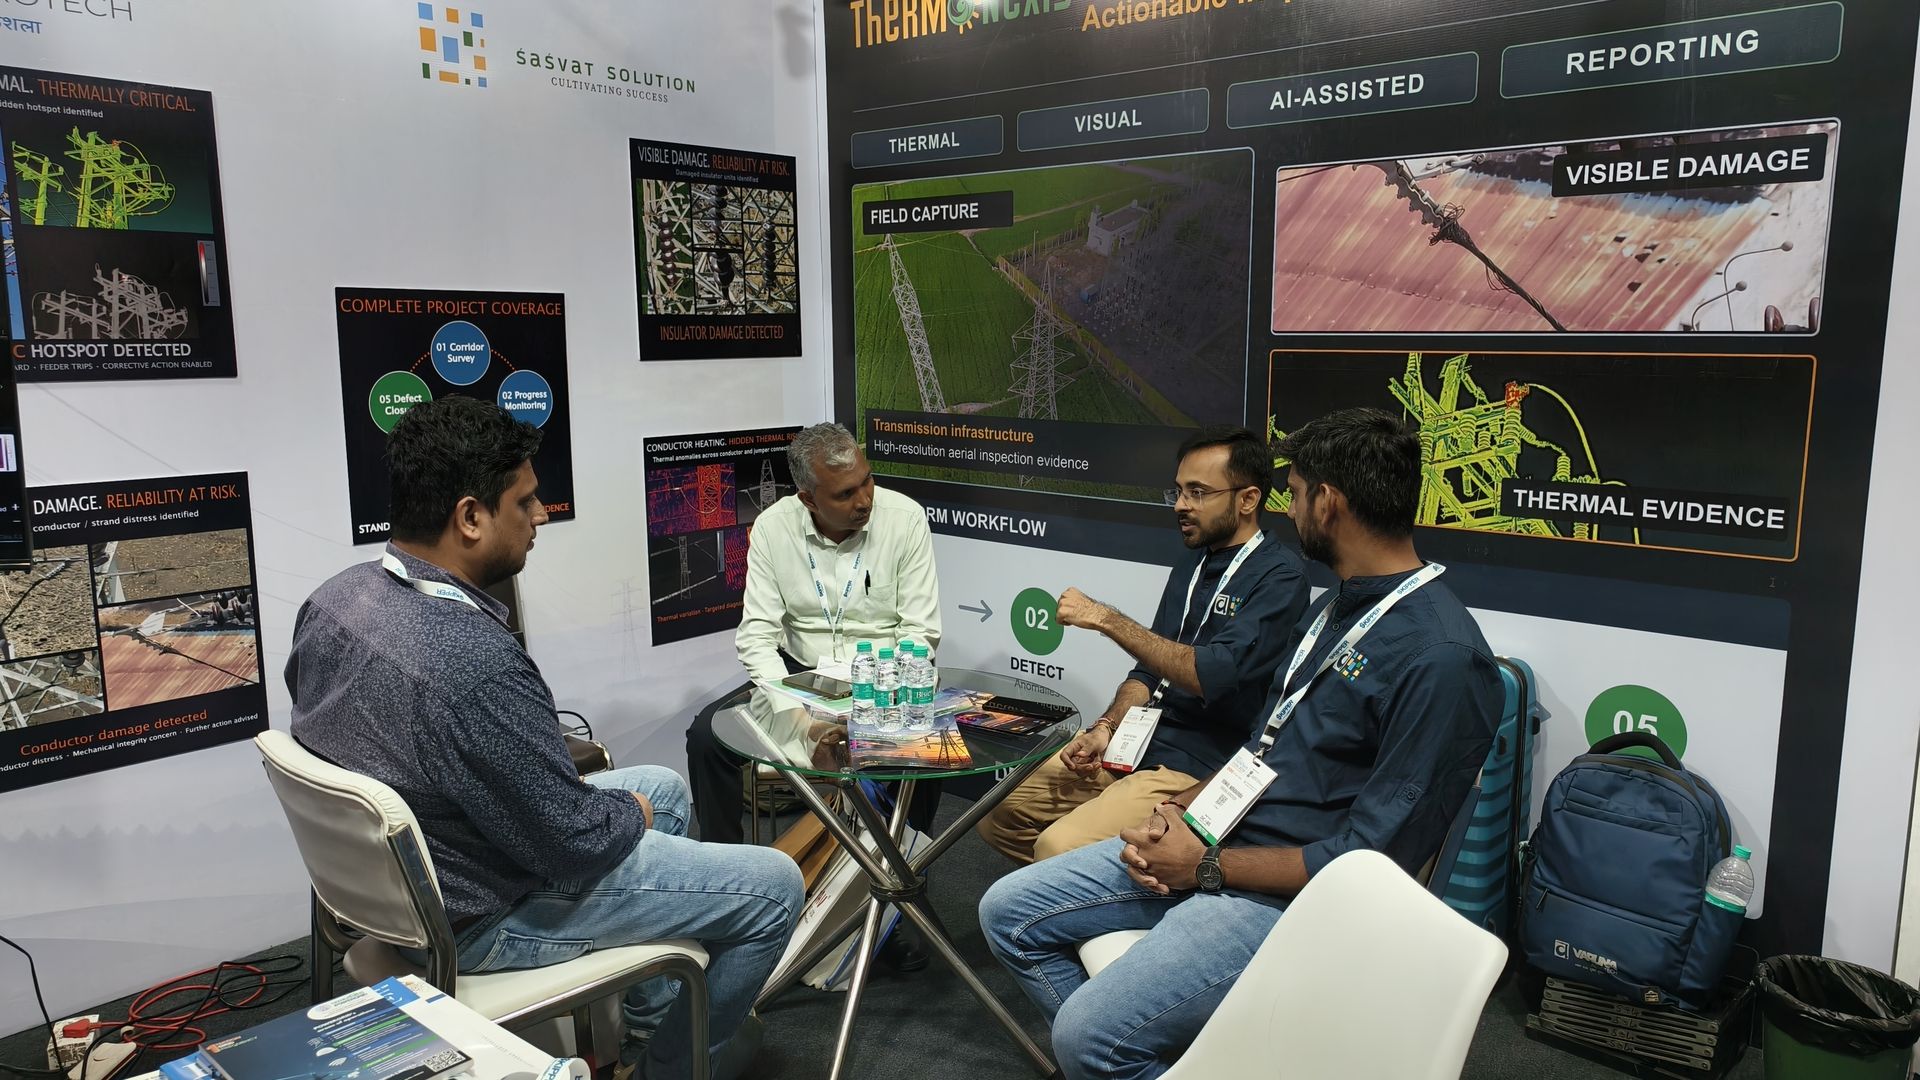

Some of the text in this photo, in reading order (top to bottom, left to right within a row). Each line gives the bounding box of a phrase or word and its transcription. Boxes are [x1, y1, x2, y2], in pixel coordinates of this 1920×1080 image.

[1565, 29, 1760, 75] REPORTING
[37, 79, 125, 104] THERMALLY
[129, 91, 196, 112] CRITICAL.
[551, 77, 669, 103] CULTIVATING SUCCESS
[1269, 73, 1425, 111] AI-ASSISTED
[27, 102, 61, 114] hotspot
[63, 106, 104, 119] identified
[1074, 109, 1142, 133] VISUAL
[888, 131, 960, 154] THERMAL
[638, 145, 790, 176] VISIBLE DAMAGE. RELIABILITY AT RISK.
[1565, 148, 1810, 187] VISIBLE DAMAGE
[870, 202, 979, 225] FIELD CAPTURE
[340, 298, 562, 316] COMPLETE PROJECT COVERAGE
[660, 325, 784, 341] INSULATOR DAMAGE DETECTED
[31, 344, 108, 359] HOTSPOT
[113, 343, 192, 357] DETECTED
[436, 342, 485, 352] 01 Corridor
[40, 363, 70, 371] FEEDER
[102, 362, 150, 370] CORRECTIVE
[151, 361, 180, 369] ACTION
[181, 360, 213, 368] ENABLED
[447, 354, 475, 364] Survey
[379, 393, 423, 404] 05 Defect
[502, 390, 548, 401] 02 Progress
[505, 401, 547, 411] Monitoring
[873, 418, 1034, 443] Transmission infrastructure
[646, 432, 799, 453] CONDUCTOR HEATING. HIDDEN THERMAL RIS
[653, 454, 675, 463] Thermal
[675, 452, 701, 461] anomalies
[702, 451, 719, 459] across
[874, 439, 1089, 471] High-resolution aerial inspection evidence
[33, 484, 241, 515] DAMAGE. RELIABILITY AT RISK.
[1513, 488, 1785, 529] THERMAL EVIDENCE
[33, 520, 81, 532] conductor
[91, 516, 121, 527] strand
[123, 513, 157, 524] distress
[159, 509, 199, 521] identified
[952, 509, 1047, 537] WORKFLOW
[1396, 576, 1420, 595] SKIPPER
[1025, 606, 1049, 630] 02
[1310, 614, 1326, 637] SKIPPER
[1359, 607, 1382, 629] SKIPPER
[1329, 640, 1350, 660] SKIPPER
[1010, 656, 1064, 681] DETECT
[1276, 699, 1293, 721] SKIPPER
[20, 709, 208, 756] Conductor damage detected
[1613, 710, 1658, 737] 05
[32, 754, 63, 766] distress
[72, 742, 115, 757] Mechanical
[116, 736, 148, 750] integrity
[149, 731, 177, 742] concern
[185, 723, 210, 734] Further
[212, 718, 233, 729] action
[234, 713, 259, 725] advised
